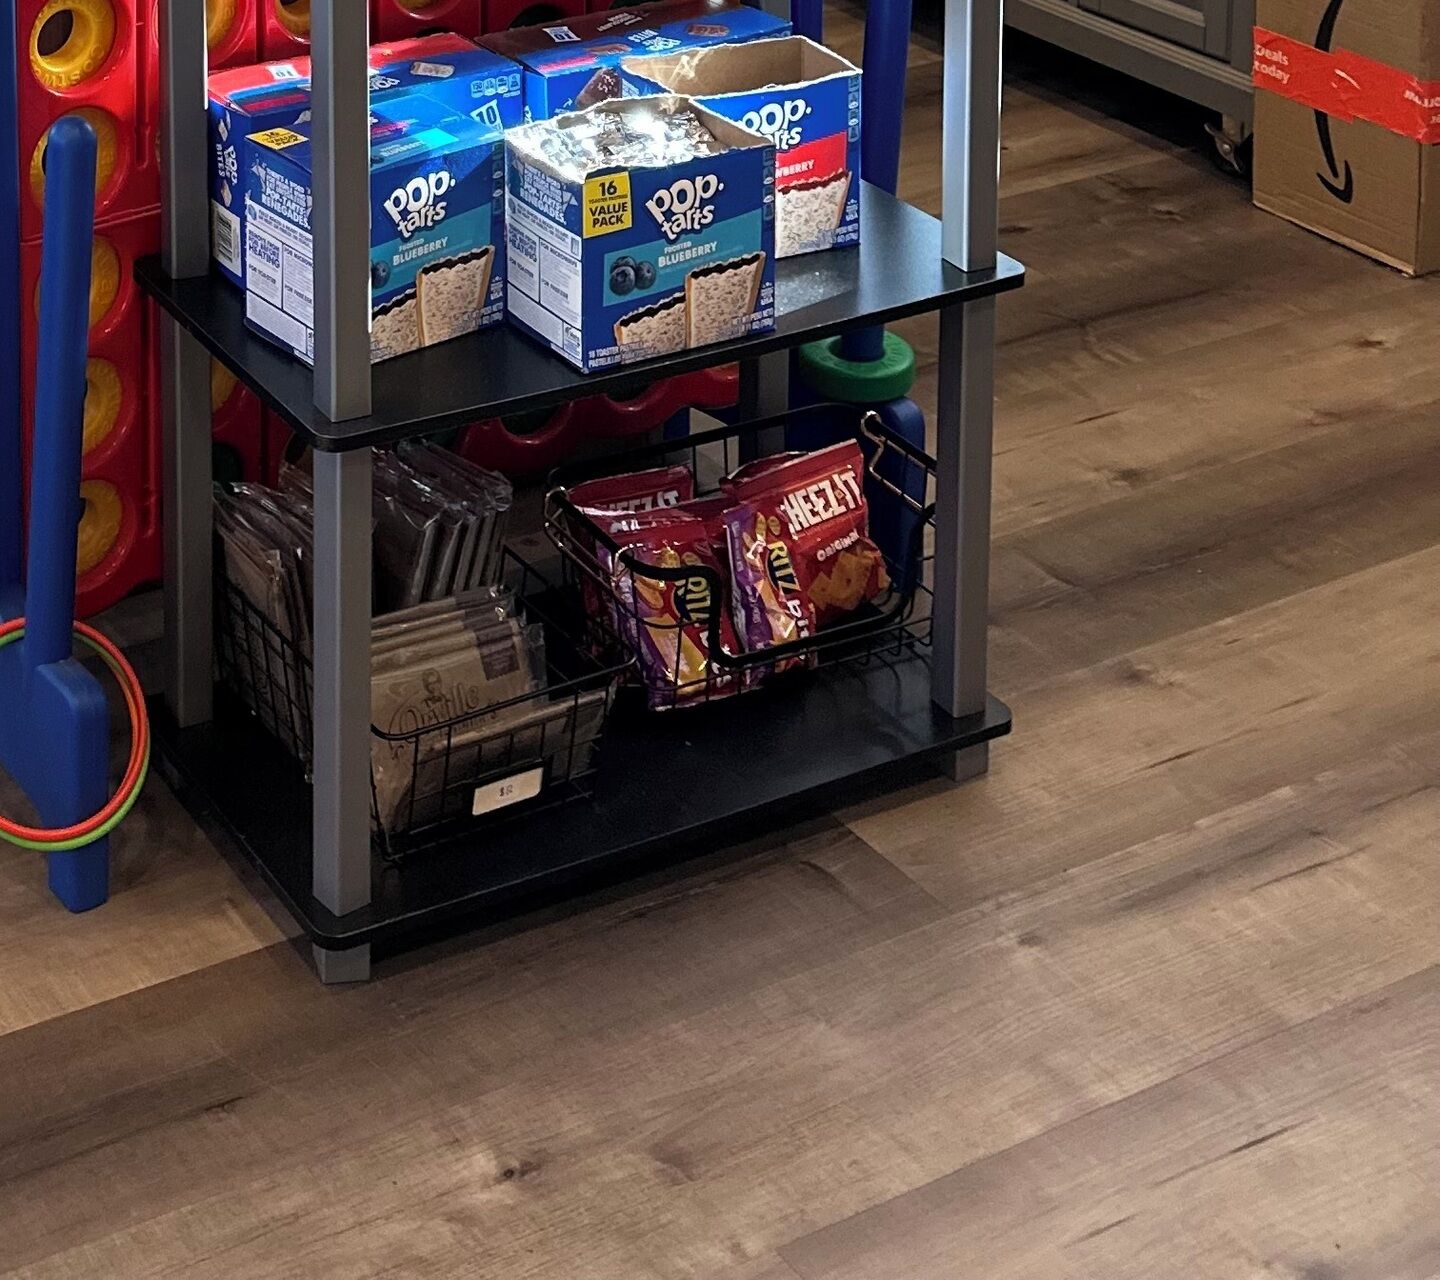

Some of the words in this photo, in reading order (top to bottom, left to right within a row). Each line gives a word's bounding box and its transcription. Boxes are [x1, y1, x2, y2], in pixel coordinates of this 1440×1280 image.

[1254, 44, 1290, 66] Deals
[1254, 60, 1291, 85] today
[599, 180, 618, 197] 16
[398, 201, 448, 239] tarts
[589, 202, 628, 218] VALUE
[592, 213, 625, 228] PACK
[662, 204, 715, 240] tarts
[393, 237, 449, 266] BLUEBERRY
[658, 241, 717, 267] BLUEBERRY
[781, 471, 862, 539] HEEZ-IT
[817, 533, 860, 561] ORIGINAL
[768, 541, 801, 592] RITZ
